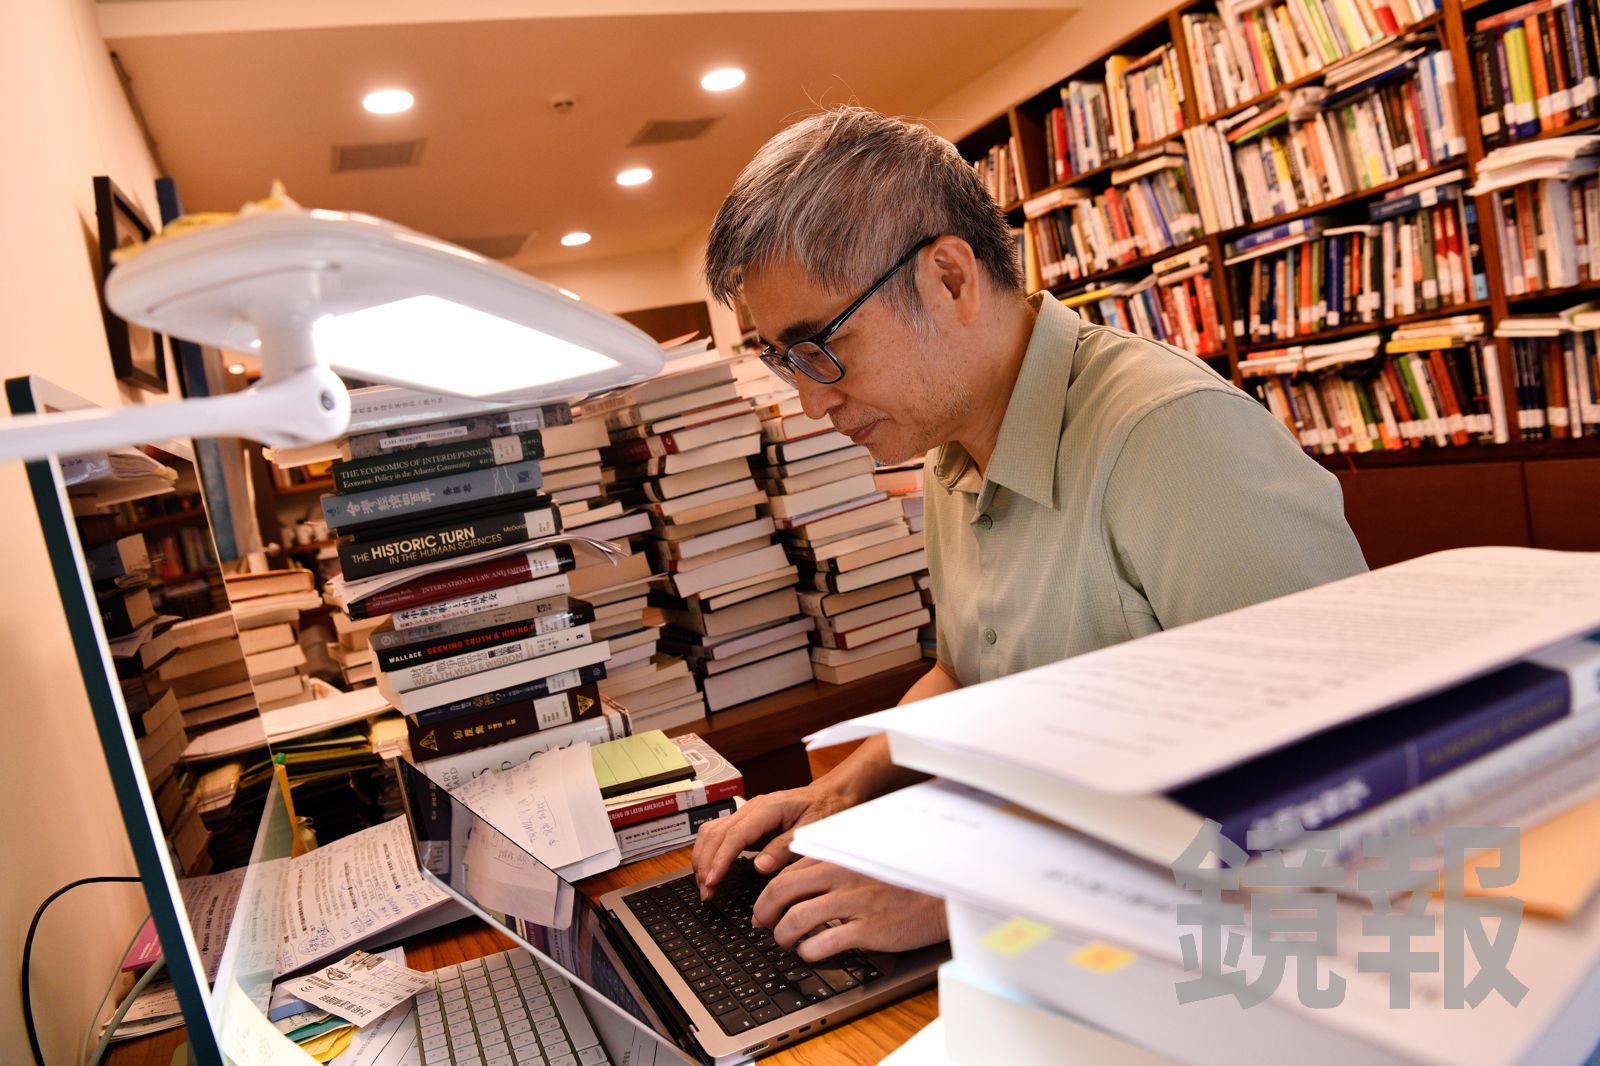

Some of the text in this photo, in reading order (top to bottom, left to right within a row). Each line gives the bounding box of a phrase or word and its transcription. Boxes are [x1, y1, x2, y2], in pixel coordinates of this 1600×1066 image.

[341, 469, 359, 479] THE
[360, 459, 409, 475] ECONOMICS
[409, 458, 420, 467] OF
[343, 477, 373, 488] Economic
[374, 473, 393, 483] Policy
[402, 470, 412, 478] the
[413, 467, 436, 476] Atlantic
[436, 460, 471, 472] Community
[352, 527, 475, 564] THE HISTORIC TURN
[389, 533, 502, 565] IN THE HUMAN SCIENCES
[422, 576, 475, 593] INTERNATIONAL
[476, 573, 490, 581] LAW
[492, 568, 507, 578] AND
[388, 651, 423, 664] WALLACE
[426, 640, 463, 655] SEEKING
[465, 634, 492, 646] TRUTH
[501, 625, 529, 637] HIDING
[486, 653, 523, 668] WISDOM
[631, 805, 644, 815] LATIN
[644, 801, 665, 812] AMERICA
[665, 798, 674, 807] AND
